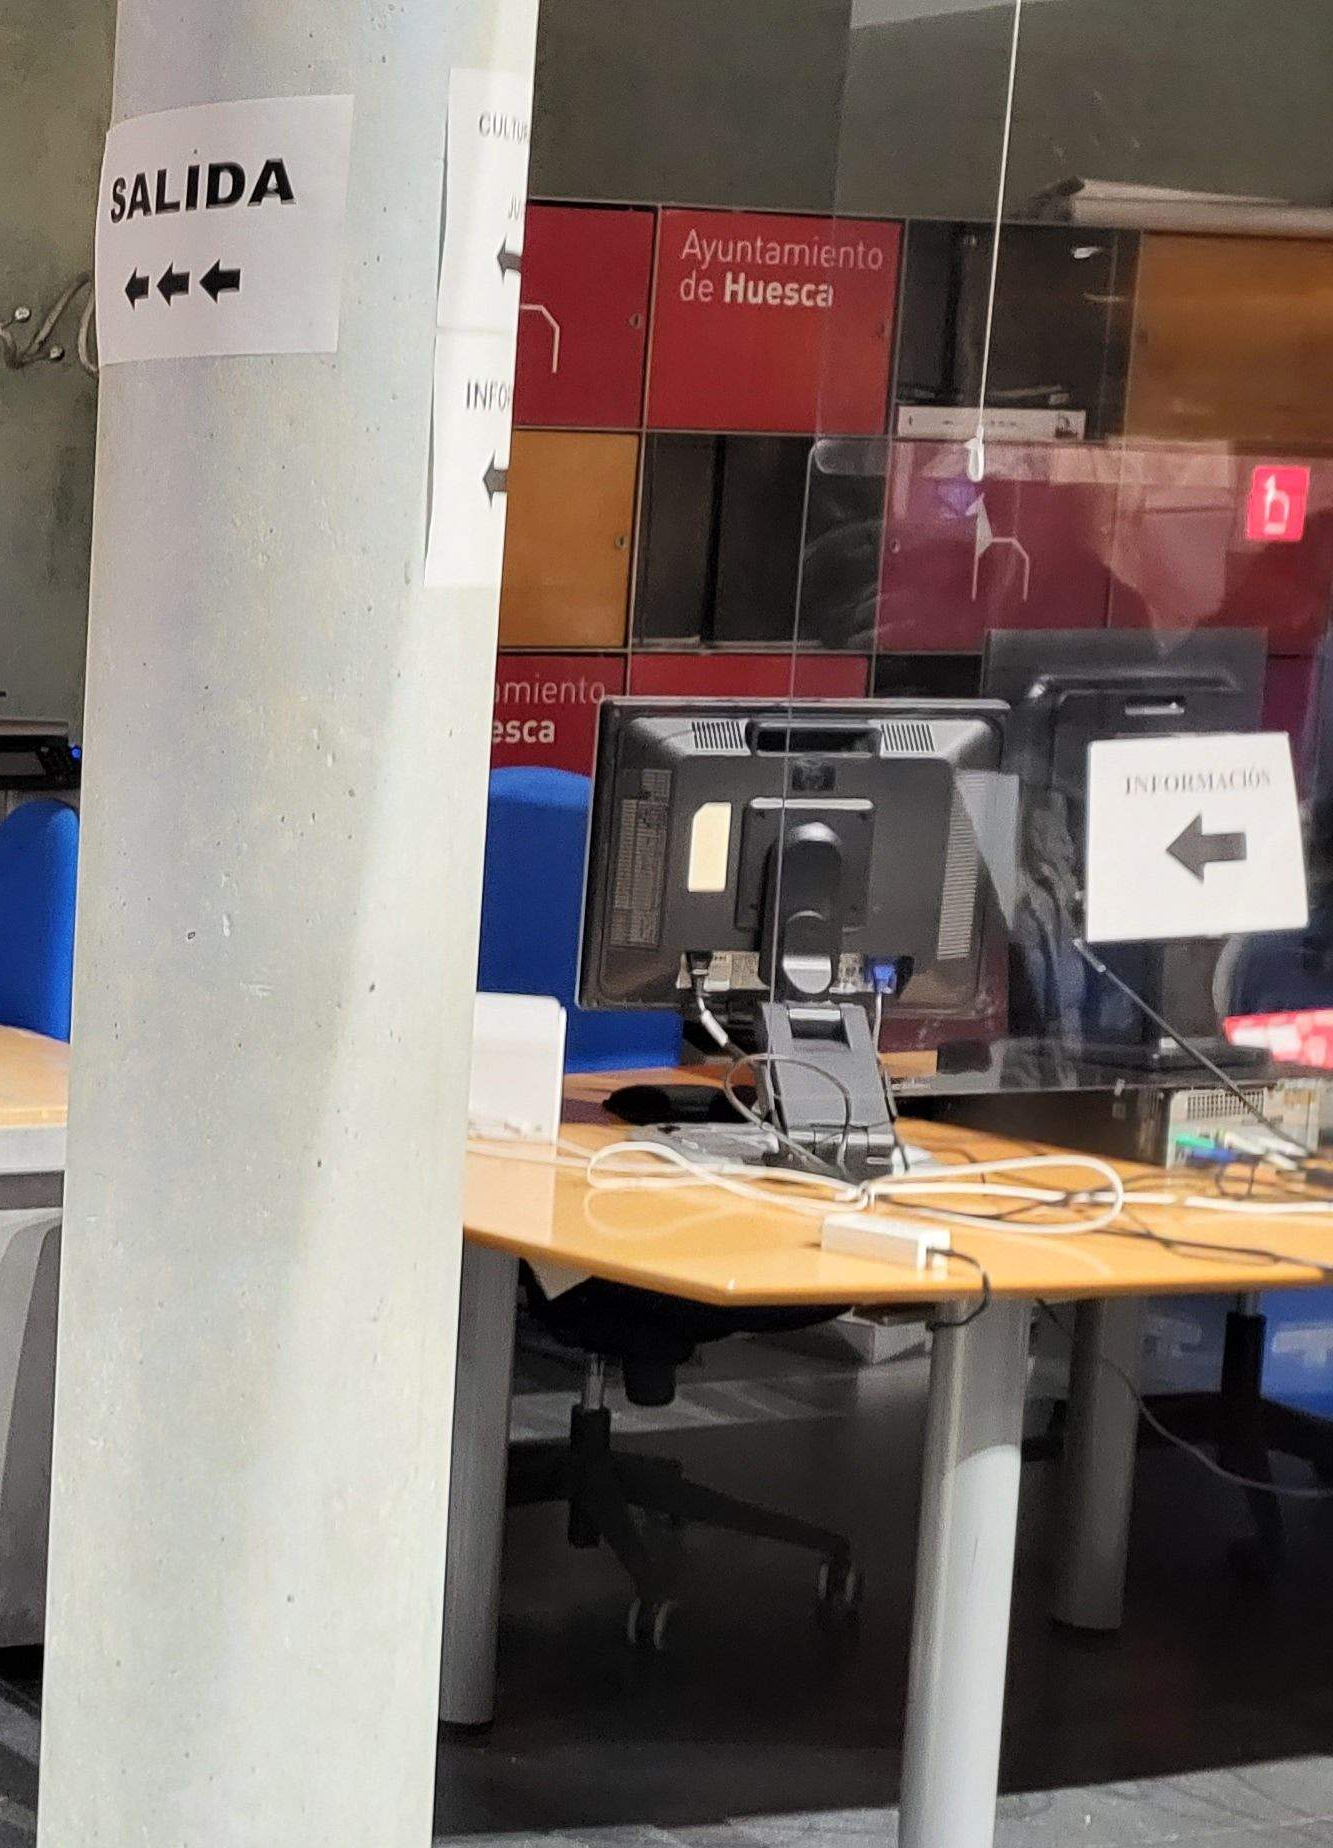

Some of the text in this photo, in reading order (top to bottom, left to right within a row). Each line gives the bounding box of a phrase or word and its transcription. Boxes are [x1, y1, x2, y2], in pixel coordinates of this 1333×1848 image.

[110, 157, 297, 224] SALIDA
[680, 228, 883, 271] Ayuntamiento
[679, 270, 833, 307] de Huesca
